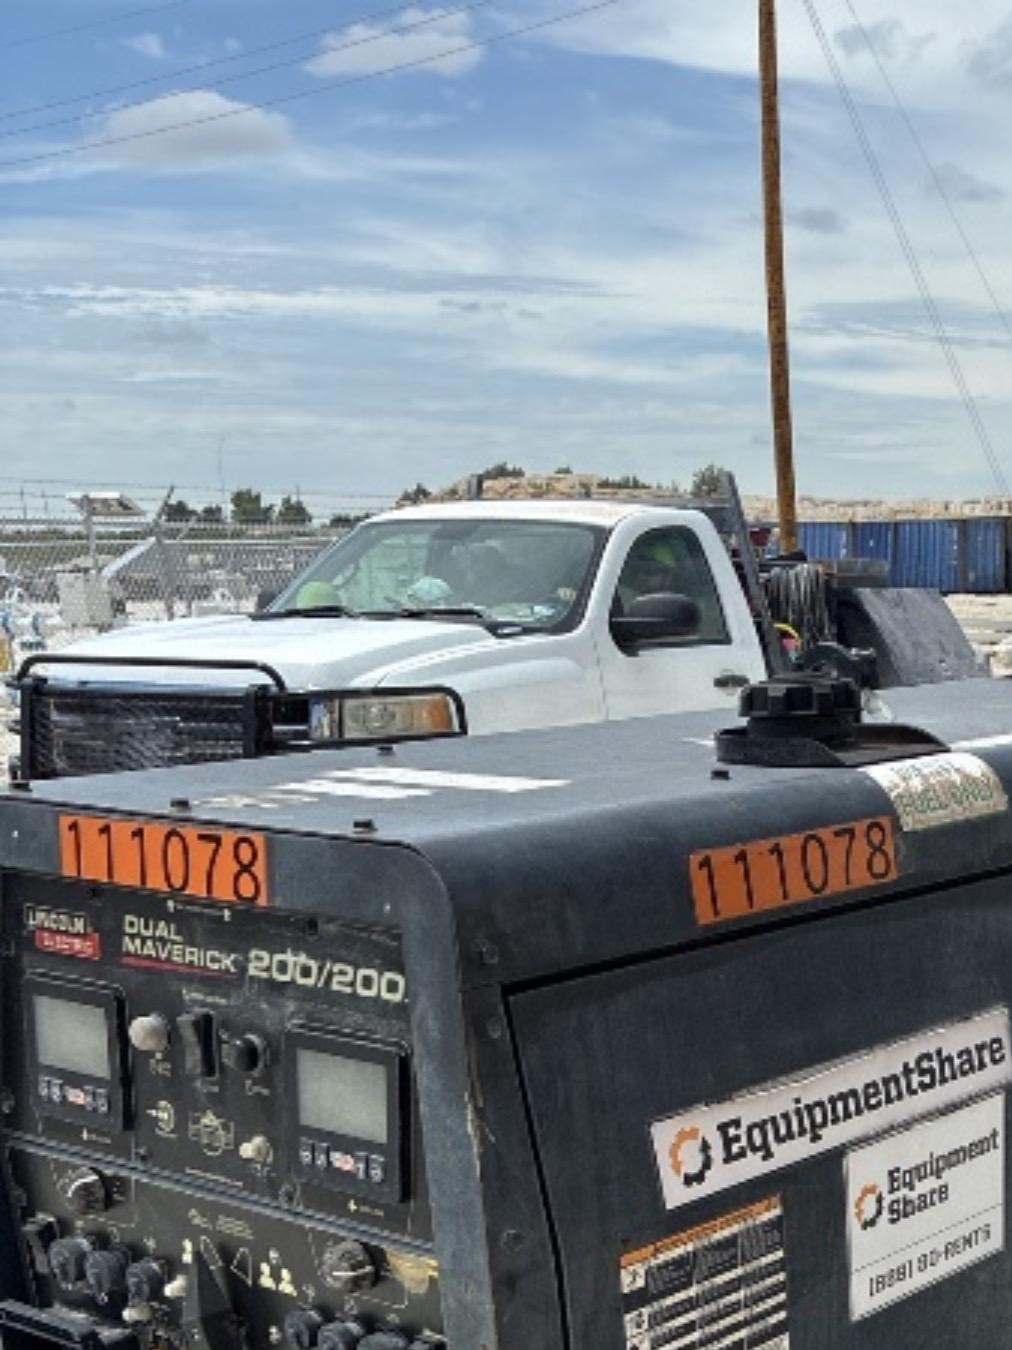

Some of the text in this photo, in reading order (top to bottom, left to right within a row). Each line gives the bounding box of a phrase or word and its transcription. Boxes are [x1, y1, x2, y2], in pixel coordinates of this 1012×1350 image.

[67, 819, 262, 903] 111078
[698, 821, 892, 918] 111078
[121, 936, 238, 973] MAVERICK
[124, 914, 183, 942] DUAL
[248, 947, 406, 1003] 200/200
[716, 1036, 1006, 1165] EquipmentShare
[887, 1127, 1000, 1195] Equipment
[887, 1183, 950, 1226] Share
